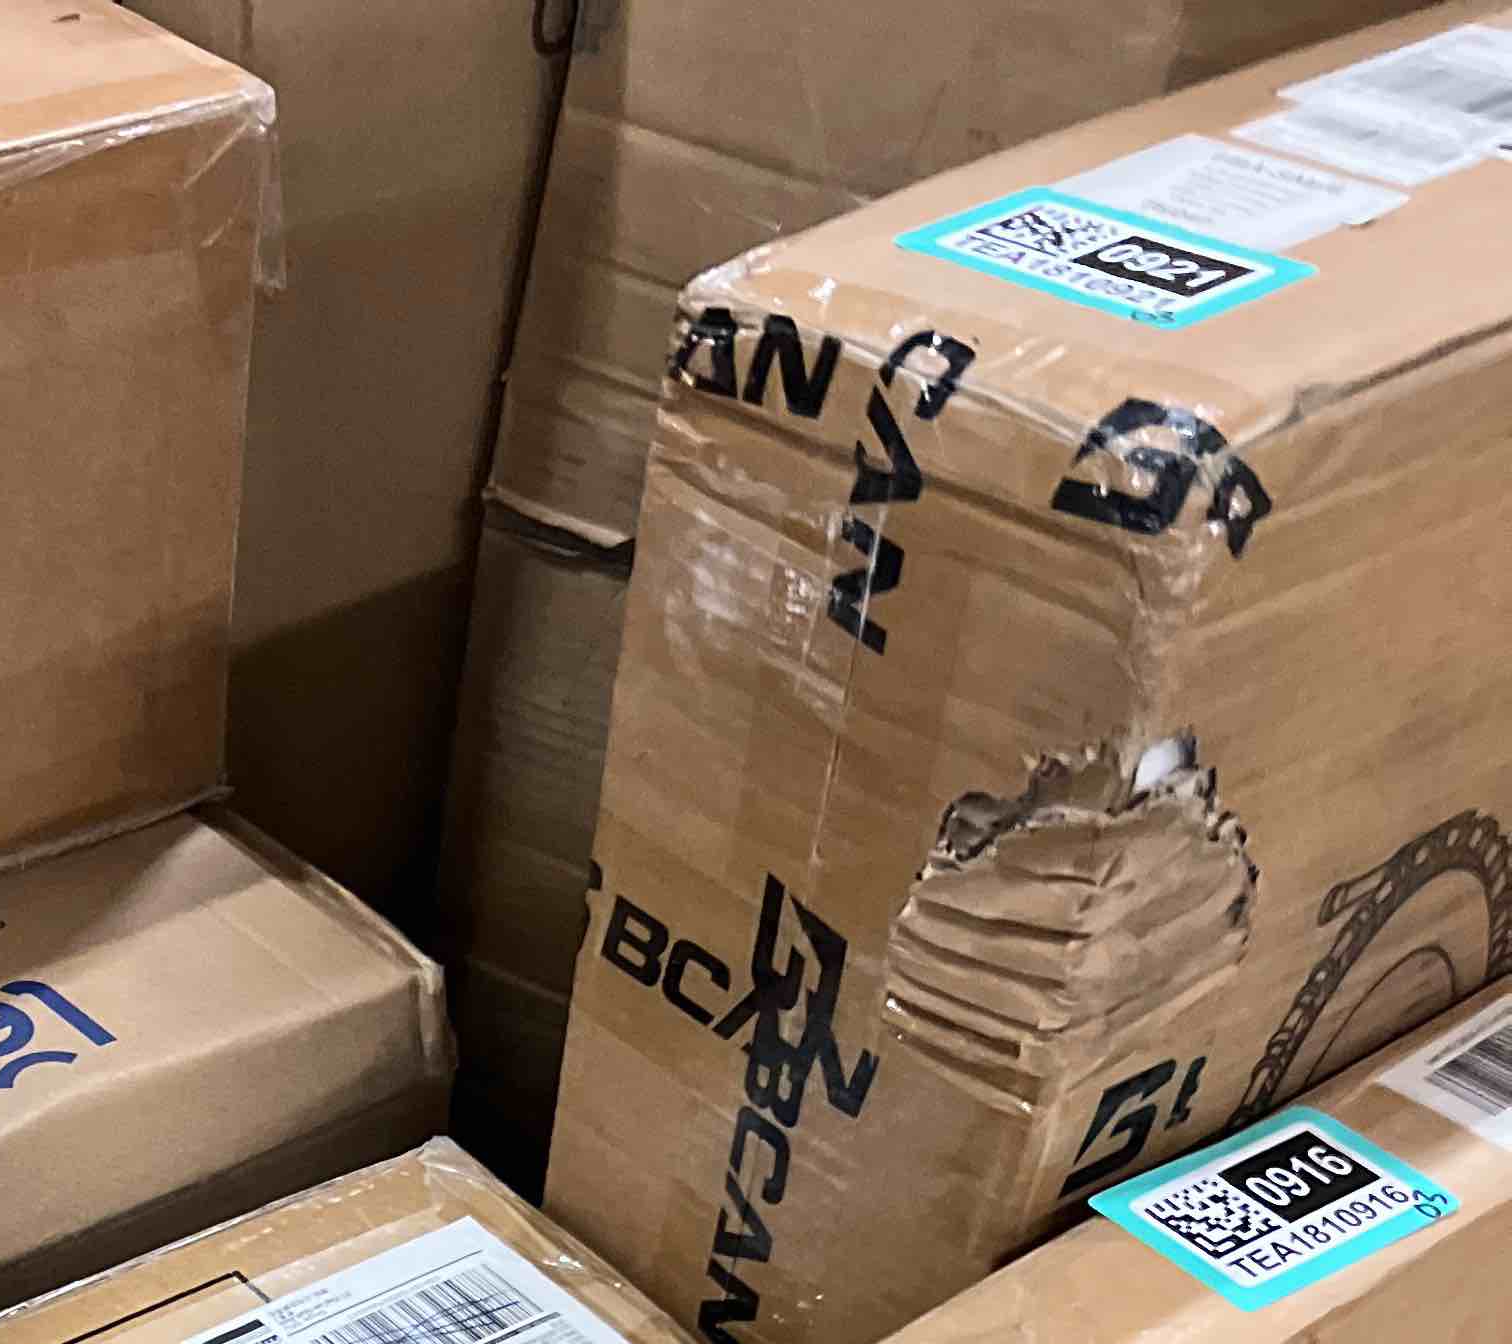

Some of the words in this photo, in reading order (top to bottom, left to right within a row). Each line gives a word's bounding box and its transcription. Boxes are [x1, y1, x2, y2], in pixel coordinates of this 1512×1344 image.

[1096, 244, 1226, 289] 0921
[1245, 1146, 1354, 1206] 0916
[1229, 1184, 1410, 1278] TEA1810916
